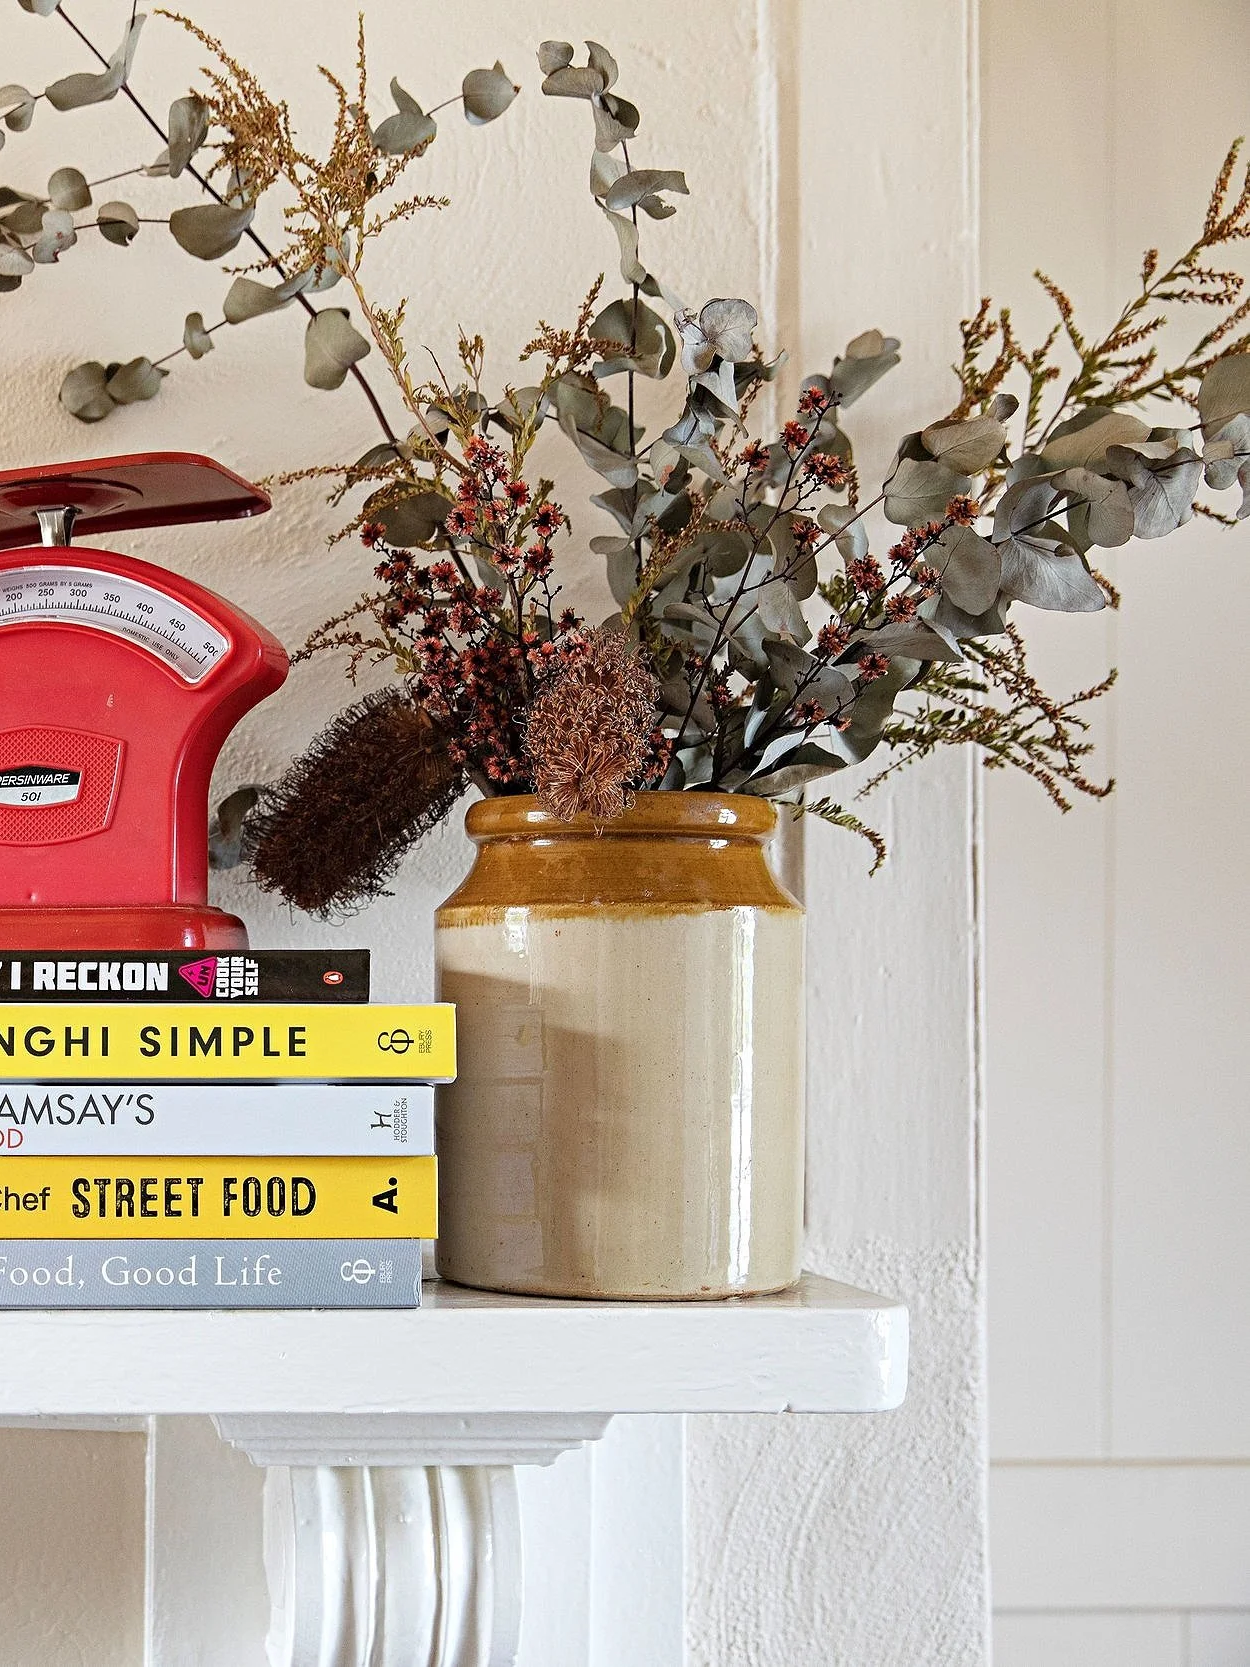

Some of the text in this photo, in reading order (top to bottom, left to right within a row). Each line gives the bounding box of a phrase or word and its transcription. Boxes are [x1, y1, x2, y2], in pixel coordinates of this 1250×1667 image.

[5, 592, 23, 602] 200
[38, 588, 55, 597] 250
[69, 588, 88, 598] 300
[103, 592, 121, 604] 350
[136, 602, 154, 615] 400
[168, 618, 186, 632] 450
[151, 641, 163, 651] USE
[165, 649, 181, 661] ONLY
[10, 961, 22, 990] I
[32, 961, 169, 991] RECKON
[197, 965, 212, 987] UN
[216, 956, 230, 998] COOK
[230, 956, 245, 999] YOUR
[245, 959, 259, 996] SELF
[139, 1025, 308, 1057] SIMPLE
[400, 1097, 408, 1143] STOUGHTON
[71, 1177, 205, 1218] STREET
[222, 1176, 317, 1218] FOOD
[100, 1255, 197, 1286] Good
[213, 1254, 283, 1286] Life
